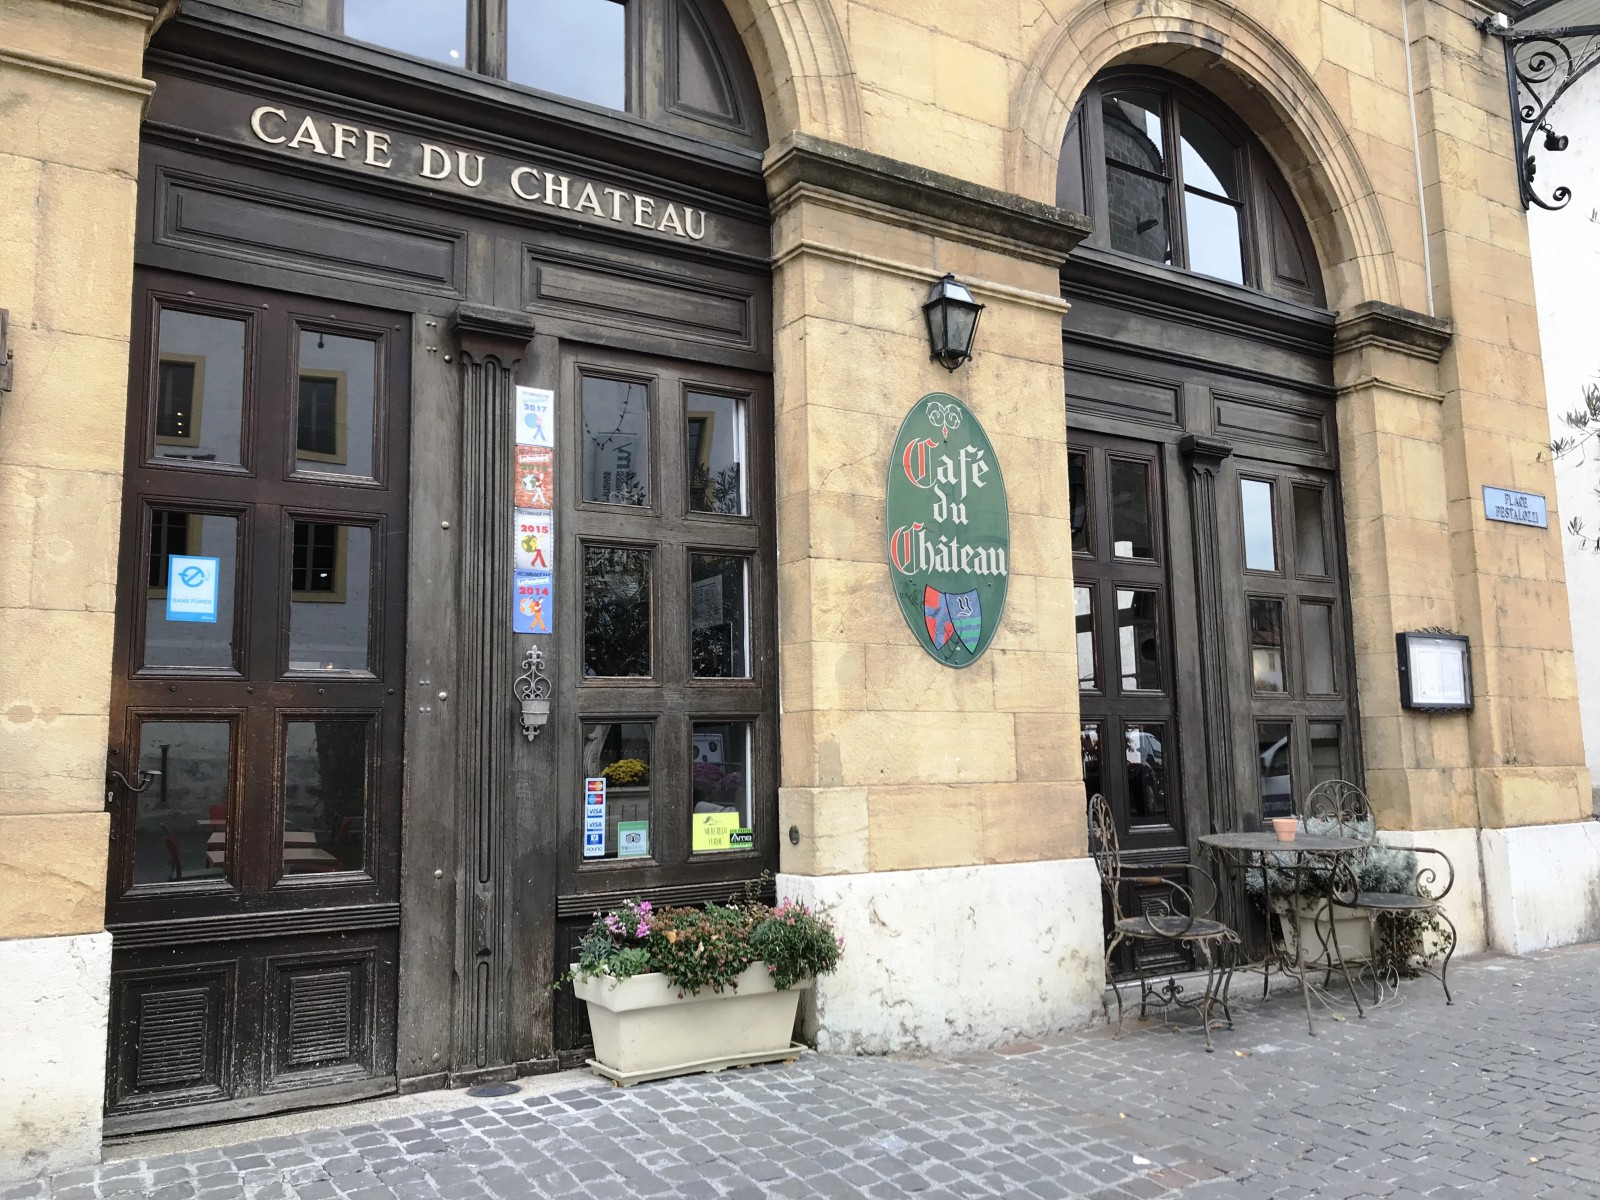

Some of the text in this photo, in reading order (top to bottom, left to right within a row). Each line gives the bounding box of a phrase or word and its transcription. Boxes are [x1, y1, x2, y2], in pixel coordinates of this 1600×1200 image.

[250, 106, 707, 240] CAFE DU CHATEAU
[524, 403, 547, 412] 2017
[903, 437, 989, 500] Café
[933, 484, 969, 525] du
[1504, 494, 1528, 508] PLACE
[521, 524, 548, 533] 2015
[890, 521, 1008, 576] Château
[519, 586, 549, 596] 2014
